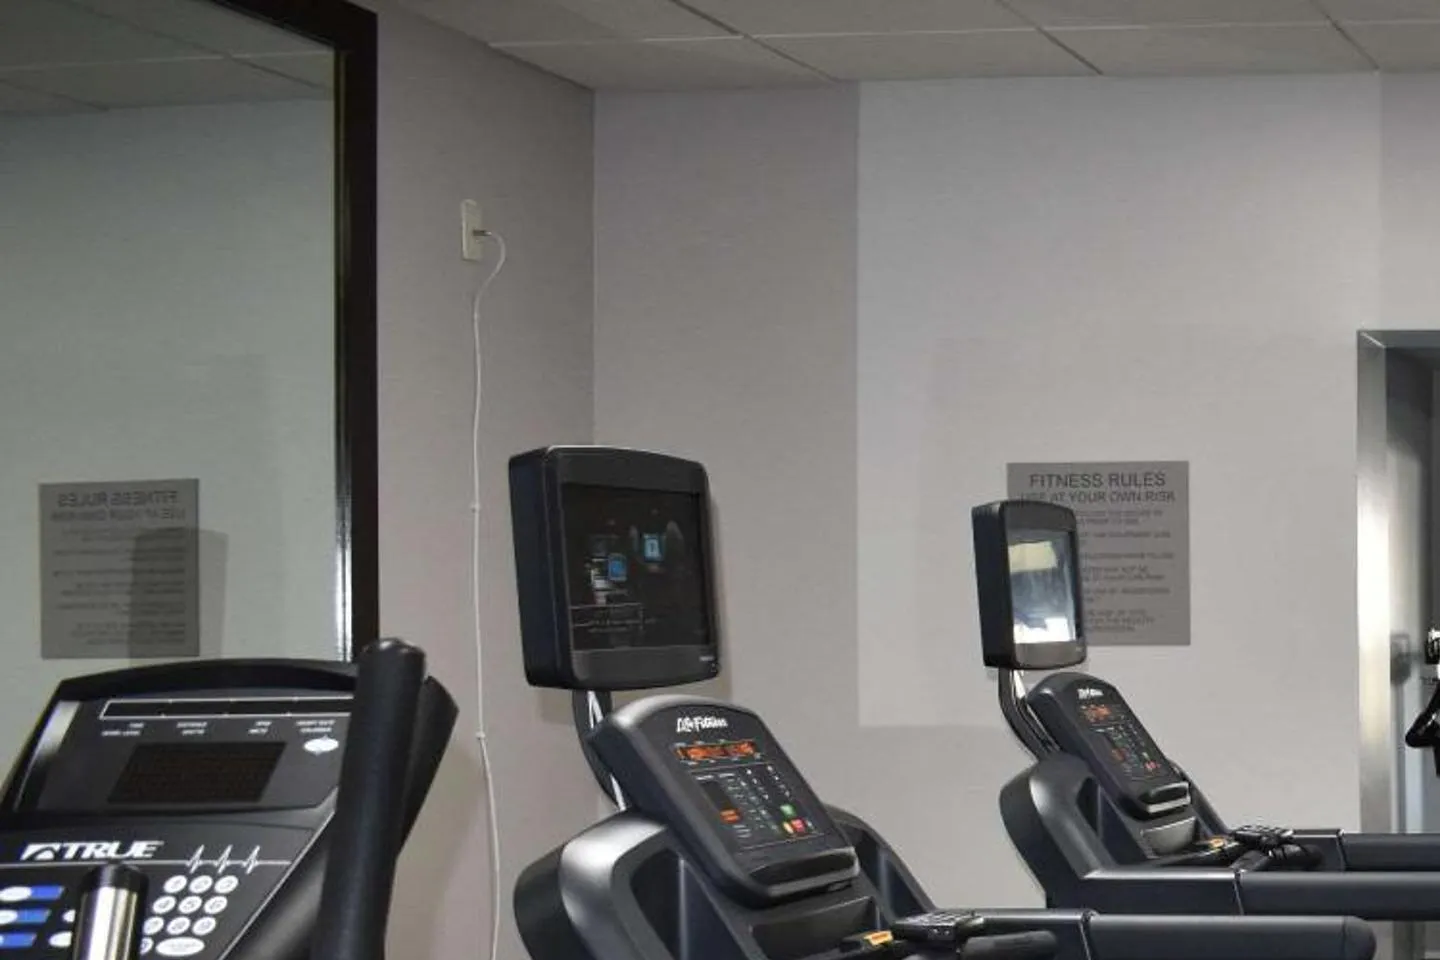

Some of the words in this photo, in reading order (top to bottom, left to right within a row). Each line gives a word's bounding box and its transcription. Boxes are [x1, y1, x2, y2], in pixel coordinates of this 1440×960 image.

[1028, 472, 1104, 489] FITNESS
[1107, 470, 1167, 488] RULES
[1067, 490, 1107, 502] YOUR
[62, 839, 165, 860] TRUE
